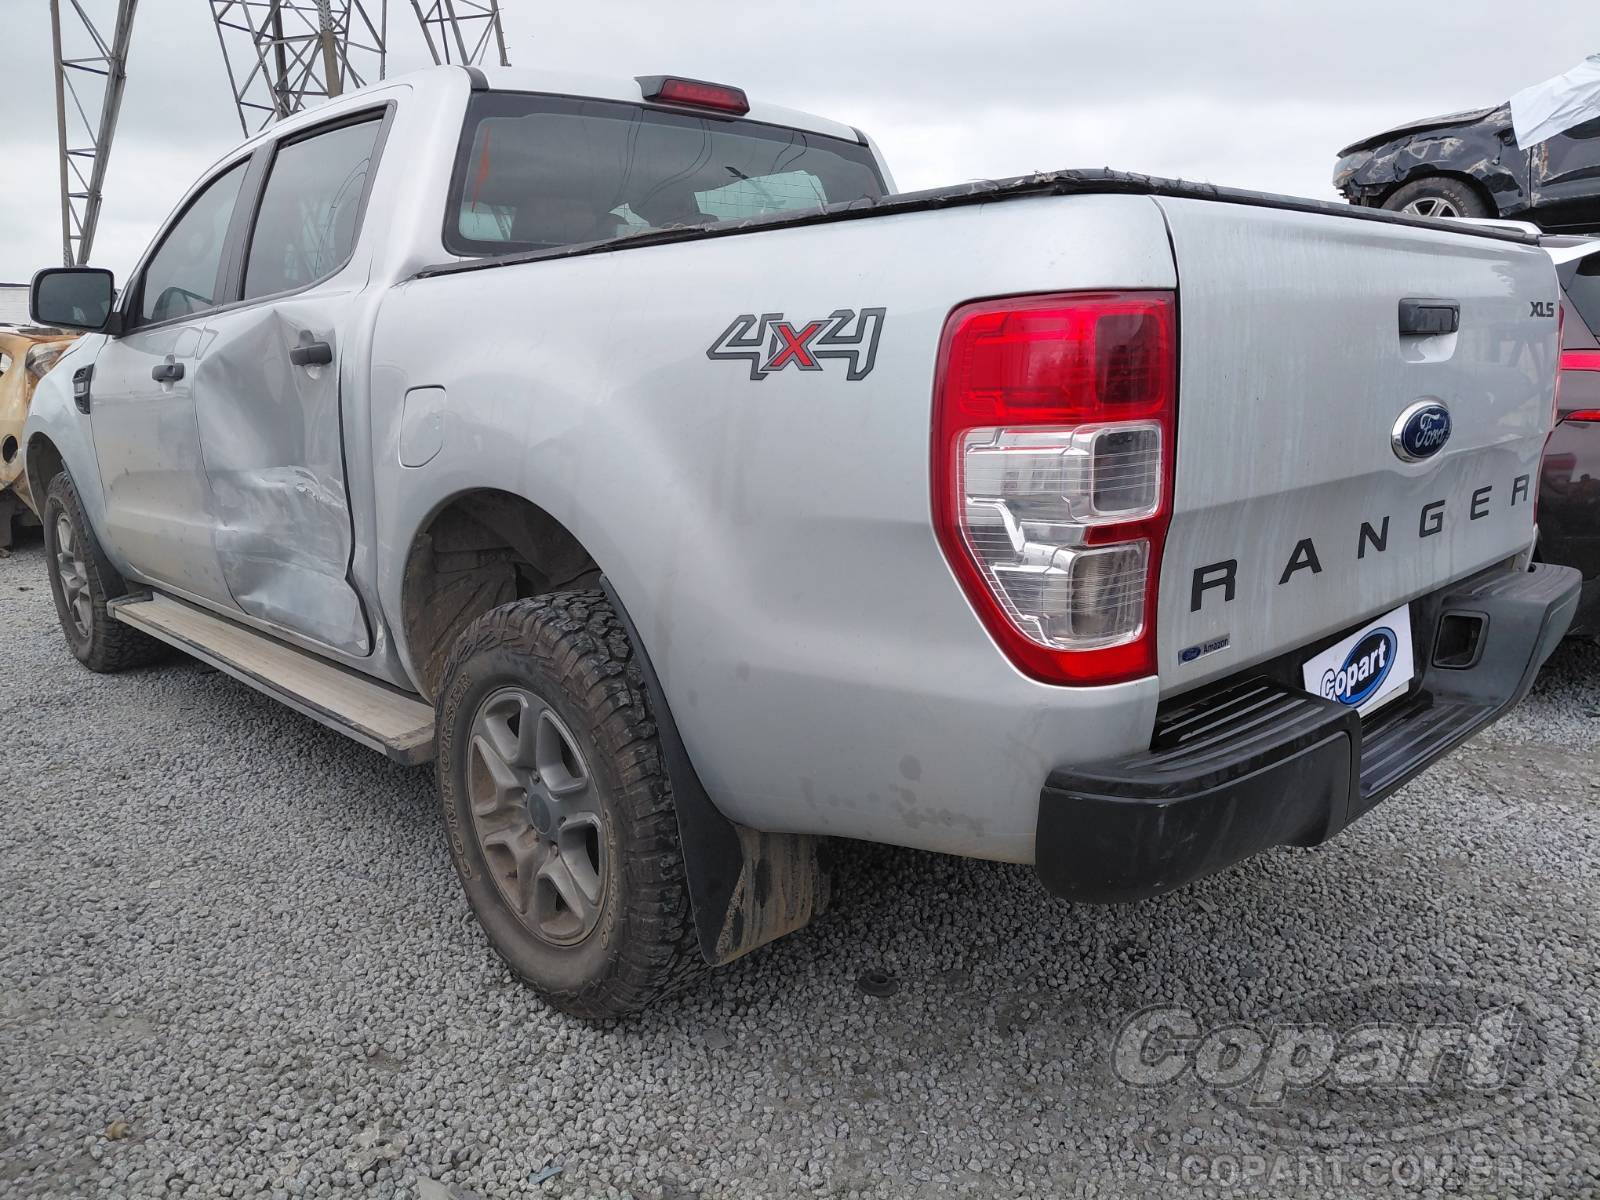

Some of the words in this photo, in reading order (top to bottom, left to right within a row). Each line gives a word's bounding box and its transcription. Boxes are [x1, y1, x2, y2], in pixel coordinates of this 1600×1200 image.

[1529, 301, 1555, 318] XLS
[1415, 413, 1447, 449] Ford
[1190, 474, 1531, 613] RANGER
[1203, 638, 1229, 655] Amazon
[1320, 638, 1387, 701] Copart
